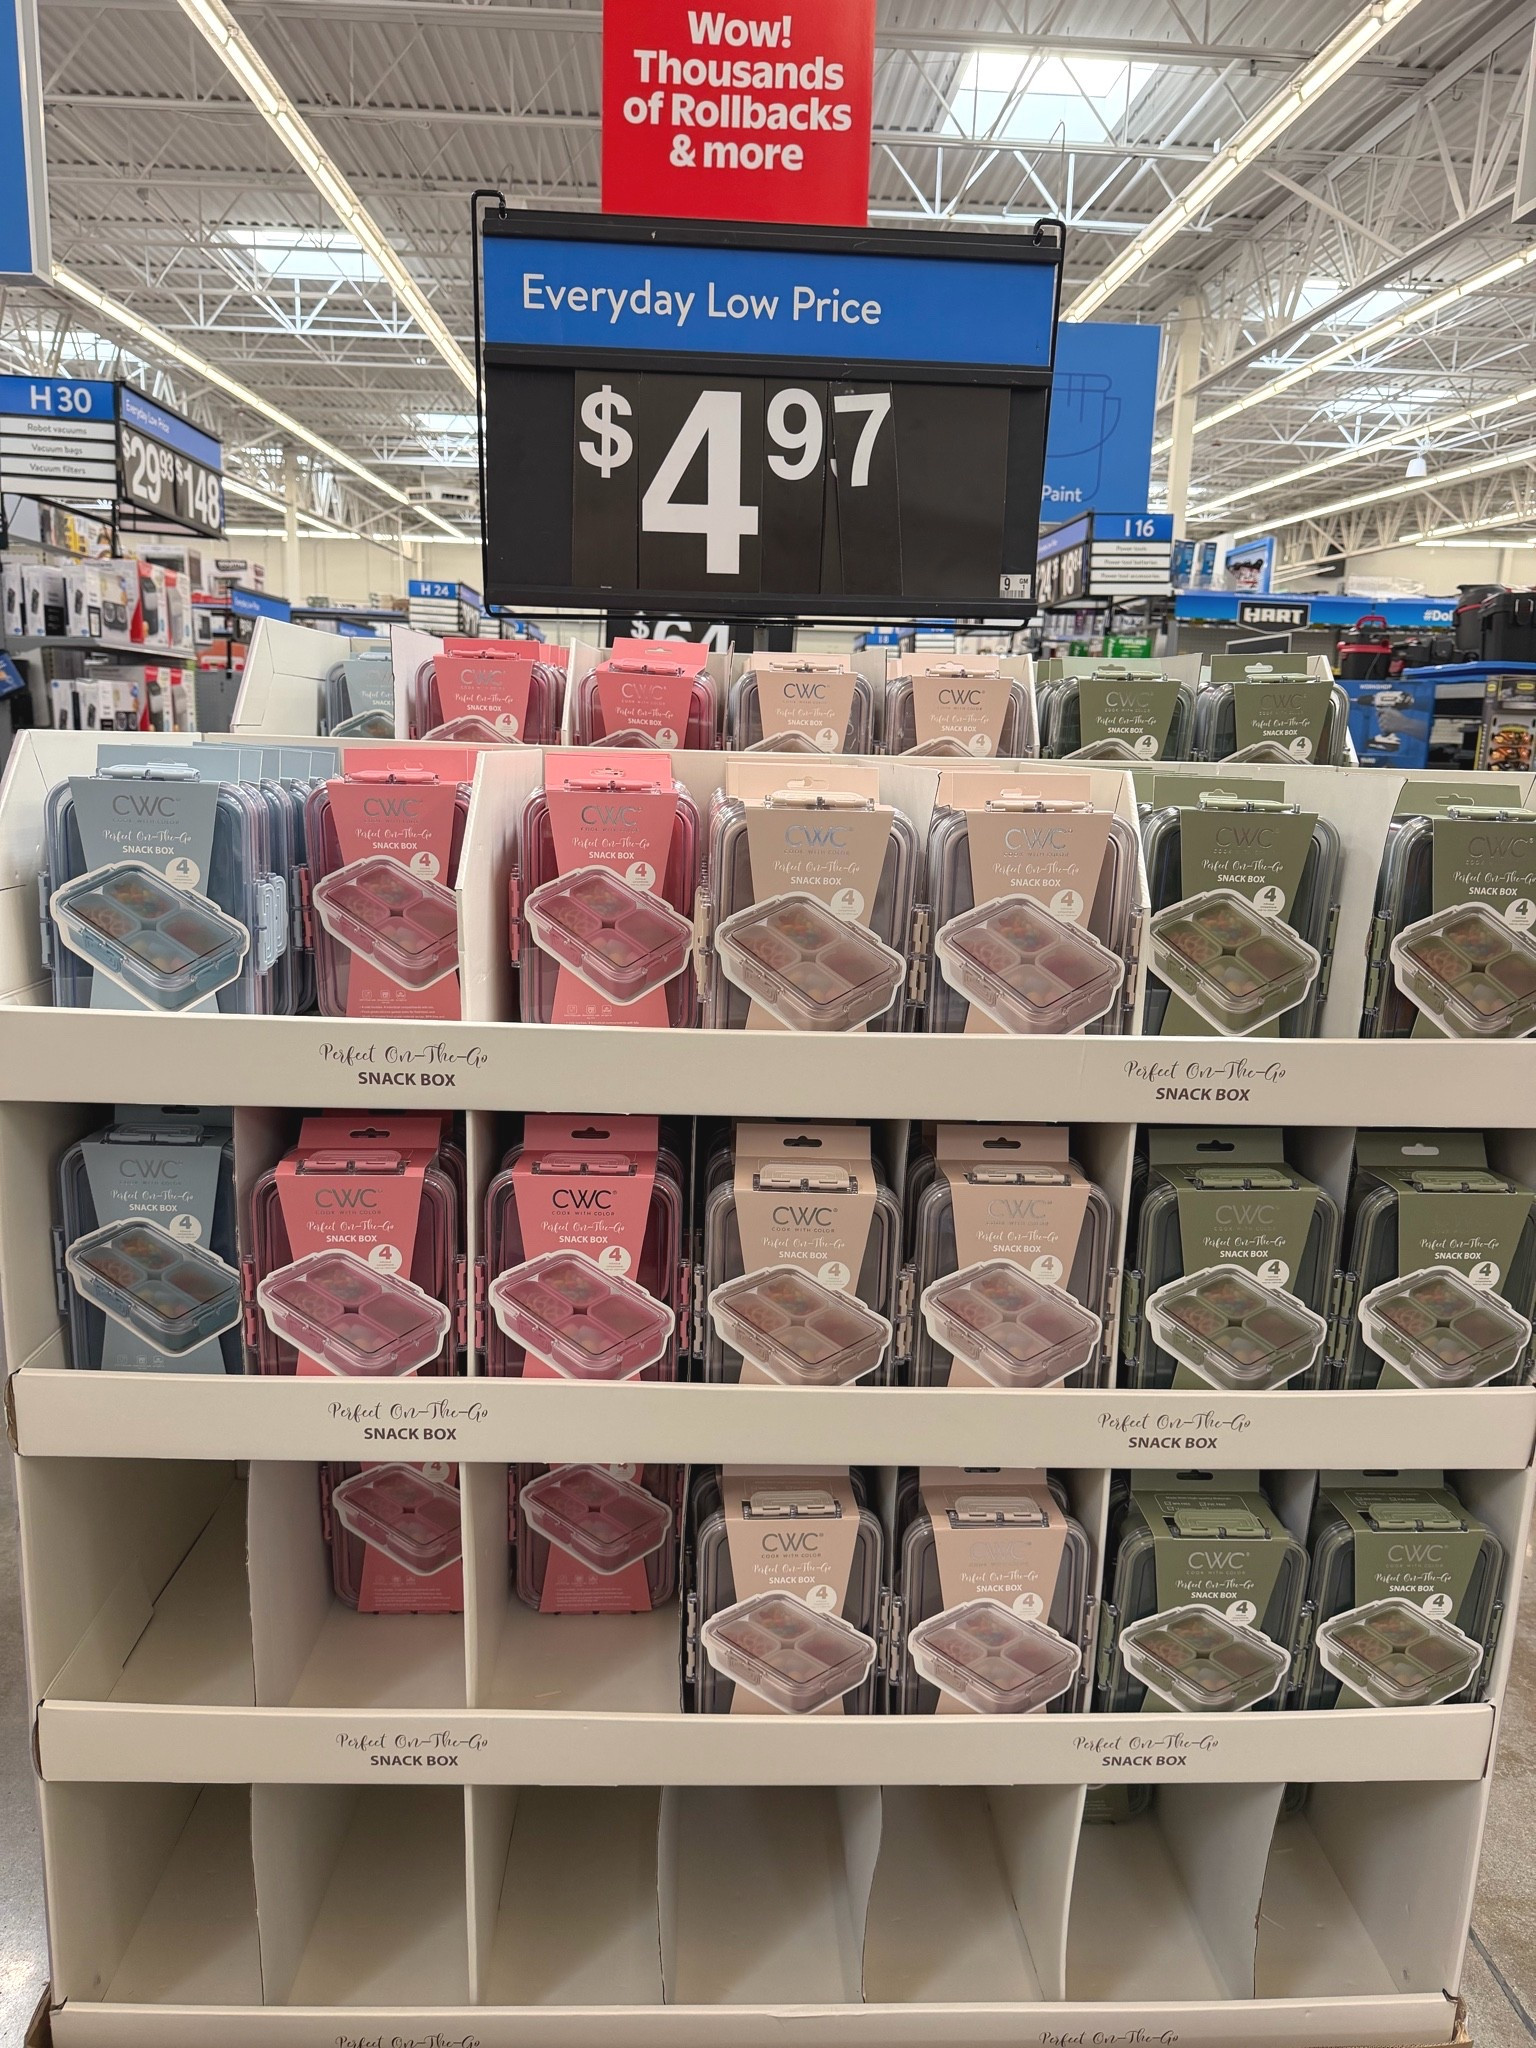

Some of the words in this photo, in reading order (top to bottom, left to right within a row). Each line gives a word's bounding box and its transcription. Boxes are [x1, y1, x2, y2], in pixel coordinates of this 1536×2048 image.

[688, 11, 792, 48] Wow!
[634, 49, 844, 90] Thousands
[623, 91, 664, 125] of
[672, 93, 851, 131] Rollbacks
[669, 134, 696, 168] &
[704, 141, 804, 171] more
[523, 273, 695, 327] Everyday
[708, 282, 780, 320] Low
[793, 286, 882, 325] Price
[30, 385, 51, 411] H
[57, 386, 92, 414] 30
[28, 423, 52, 432] Robot
[54, 425, 88, 435] vacuums
[32, 443, 62, 454] Vacuum
[64, 445, 83, 456] bags
[30, 463, 61, 473] Vacuum
[63, 464, 86, 475] filters
[1041, 484, 1082, 502] Paint
[1124, 520, 1130, 537] I
[1136, 519, 1155, 538] 16
[421, 584, 432, 595] H
[434, 584, 449, 596] 24
[1004, 578, 1010, 590] 9
[1244, 607, 1304, 624] HART
[784, 683, 826, 700] CWC
[938, 690, 980, 706] CWC
[650, 718, 662, 726] BOX
[112, 795, 176, 817] CWC
[364, 798, 420, 818] CWC
[581, 806, 637, 826] CWC
[785, 826, 847, 848] CWC
[1005, 828, 1066, 850] CWC
[122, 845, 154, 854] SNACK
[156, 846, 174, 854] BOX
[372, 842, 399, 850] SNACK
[400, 842, 417, 850] BOX
[418, 853, 431, 866] 4
[589, 851, 616, 859] SNACK
[618, 852, 634, 860] BOX
[176, 860, 190, 874] 4
[635, 864, 647, 877] 4
[790, 876, 820, 885] SNACK
[822, 877, 842, 886] BOX
[1010, 878, 1040, 886] SNACK
[1042, 878, 1061, 887] BOX
[1217, 874, 1246, 882] SNACK
[1248, 874, 1265, 883] BOX
[842, 890, 855, 905] 4
[1060, 891, 1074, 906] 4
[1264, 888, 1276, 902] 4
[1468, 887, 1498, 896] SNACK
[1500, 888, 1518, 896] BOX
[1516, 901, 1529, 916] 4
[319, 1043, 376, 1066] Perfect
[385, 1042, 488, 1068] On-The-Go
[1124, 1060, 1178, 1082] Perfect
[1186, 1058, 1286, 1083] On-The-Go
[358, 1072, 416, 1086] SNACK
[420, 1074, 456, 1086] BOX
[1156, 1088, 1213, 1100] SNACK
[1216, 1088, 1250, 1101] BOX
[120, 1160, 178, 1178] CWC
[315, 1188, 376, 1208] CWC
[552, 1189, 612, 1208] CWC
[160, 1204, 178, 1212] BOX
[1216, 1205, 1275, 1224] CWC
[179, 1216, 192, 1230] 4
[772, 1206, 832, 1226] CWC
[326, 1234, 356, 1242] SNACK
[559, 1236, 588, 1244] SNACK
[590, 1236, 608, 1244] BOX
[378, 1246, 392, 1260] 4
[608, 1248, 622, 1262] 4
[993, 1244, 1022, 1252] SNACK
[1220, 1250, 1248, 1258] SNACK
[1250, 1250, 1268, 1258] BOX
[778, 1251, 808, 1259] SNACK
[810, 1252, 828, 1260] BOX
[1434, 1252, 1462, 1260] SNACK
[1464, 1252, 1482, 1260] BOX
[828, 1263, 841, 1276] 4
[1040, 1257, 1054, 1270] 4
[1268, 1260, 1280, 1275] 4
[1479, 1263, 1492, 1276] 4
[328, 1402, 382, 1423] Perfect
[390, 1399, 488, 1423] On-The-Go
[1098, 1412, 1150, 1432] Perfect
[1156, 1410, 1250, 1432] On-The-Go
[364, 1428, 420, 1440] SNACK
[424, 1428, 457, 1440] BOX
[1128, 1436, 1182, 1448] SNACK
[1185, 1438, 1218, 1449] BOX
[762, 1532, 818, 1551] CWC
[1388, 1544, 1442, 1562] CWC
[1188, 1552, 1245, 1570] CWC
[769, 1576, 797, 1584] SNACK
[798, 1576, 816, 1584] BOX
[816, 1586, 828, 1600] 4
[1006, 1584, 1022, 1592] BOX
[1022, 1594, 1035, 1607] 4
[1432, 1594, 1445, 1607] 4
[1236, 1602, 1248, 1614] 4
[336, 1733, 388, 1750] Perfect
[394, 1730, 488, 1750] On-The-Go
[1073, 1736, 1122, 1752] Perfect
[1128, 1732, 1219, 1752] On-The-Go
[370, 1756, 423, 1766] SNACK
[426, 1756, 458, 1766] BOX
[1102, 1756, 1152, 1766] SNACK
[1156, 1756, 1188, 1766] BOX
[1039, 2030, 1085, 2047] Perfect
[1092, 2028, 1179, 2046] On-The-Go
